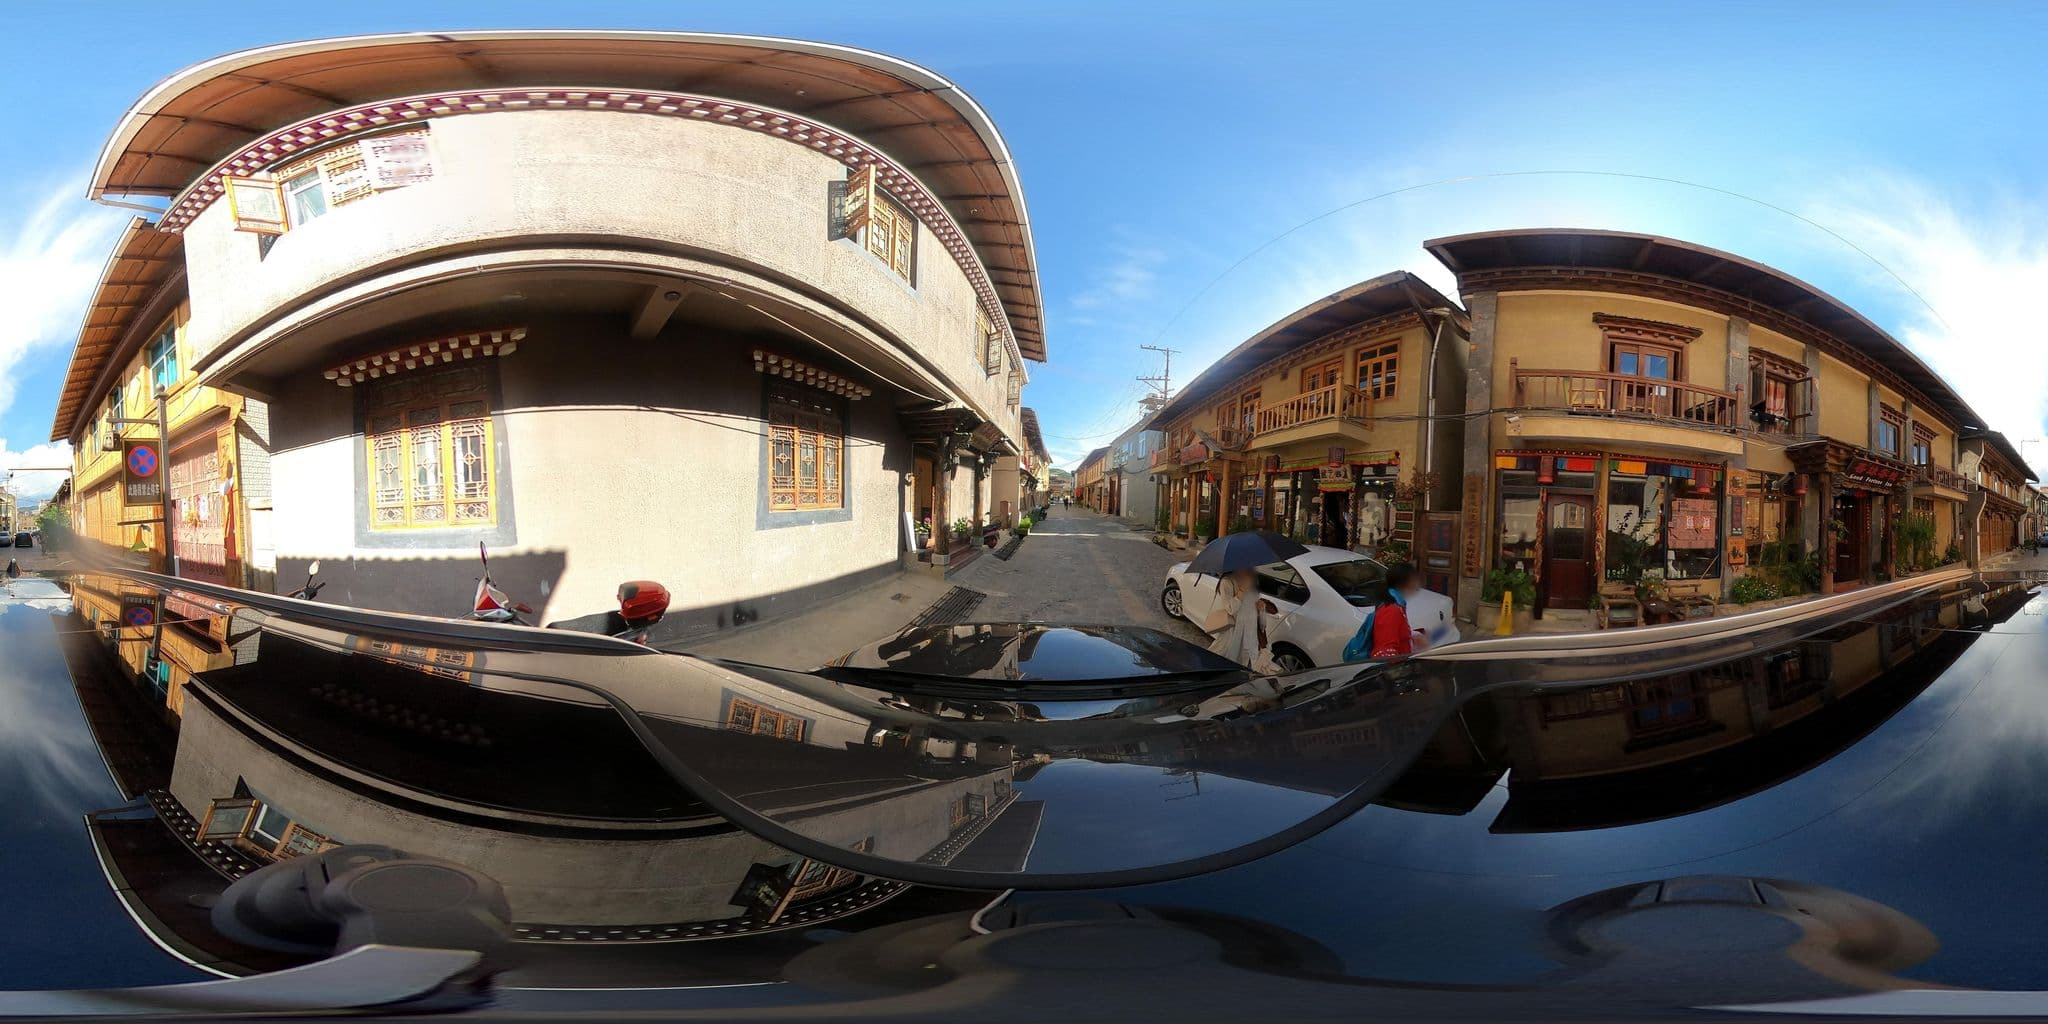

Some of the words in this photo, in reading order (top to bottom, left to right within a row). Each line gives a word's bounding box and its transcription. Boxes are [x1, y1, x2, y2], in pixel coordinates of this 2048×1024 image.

[128, 483, 160, 496] 此路段禁止停车
